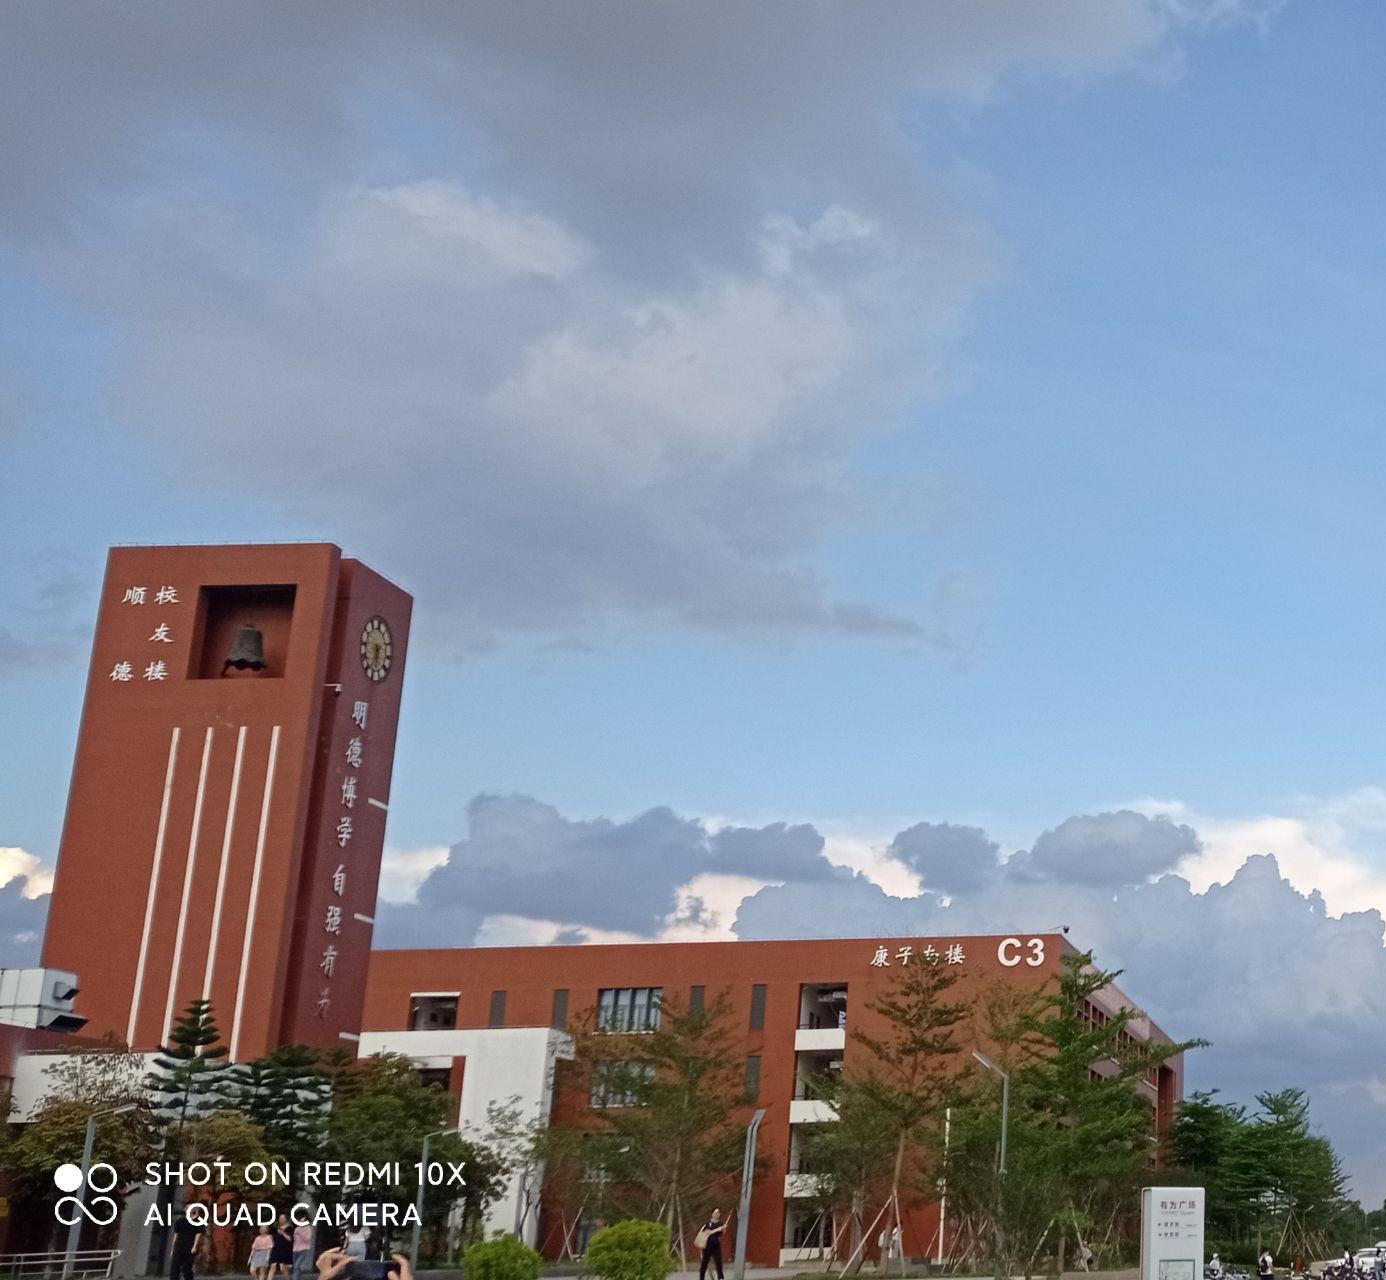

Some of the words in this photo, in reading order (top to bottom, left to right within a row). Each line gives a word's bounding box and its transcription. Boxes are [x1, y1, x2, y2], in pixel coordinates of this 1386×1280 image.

[142, 586, 181, 681] 校友楼
[997, 938, 1045, 967] C3
